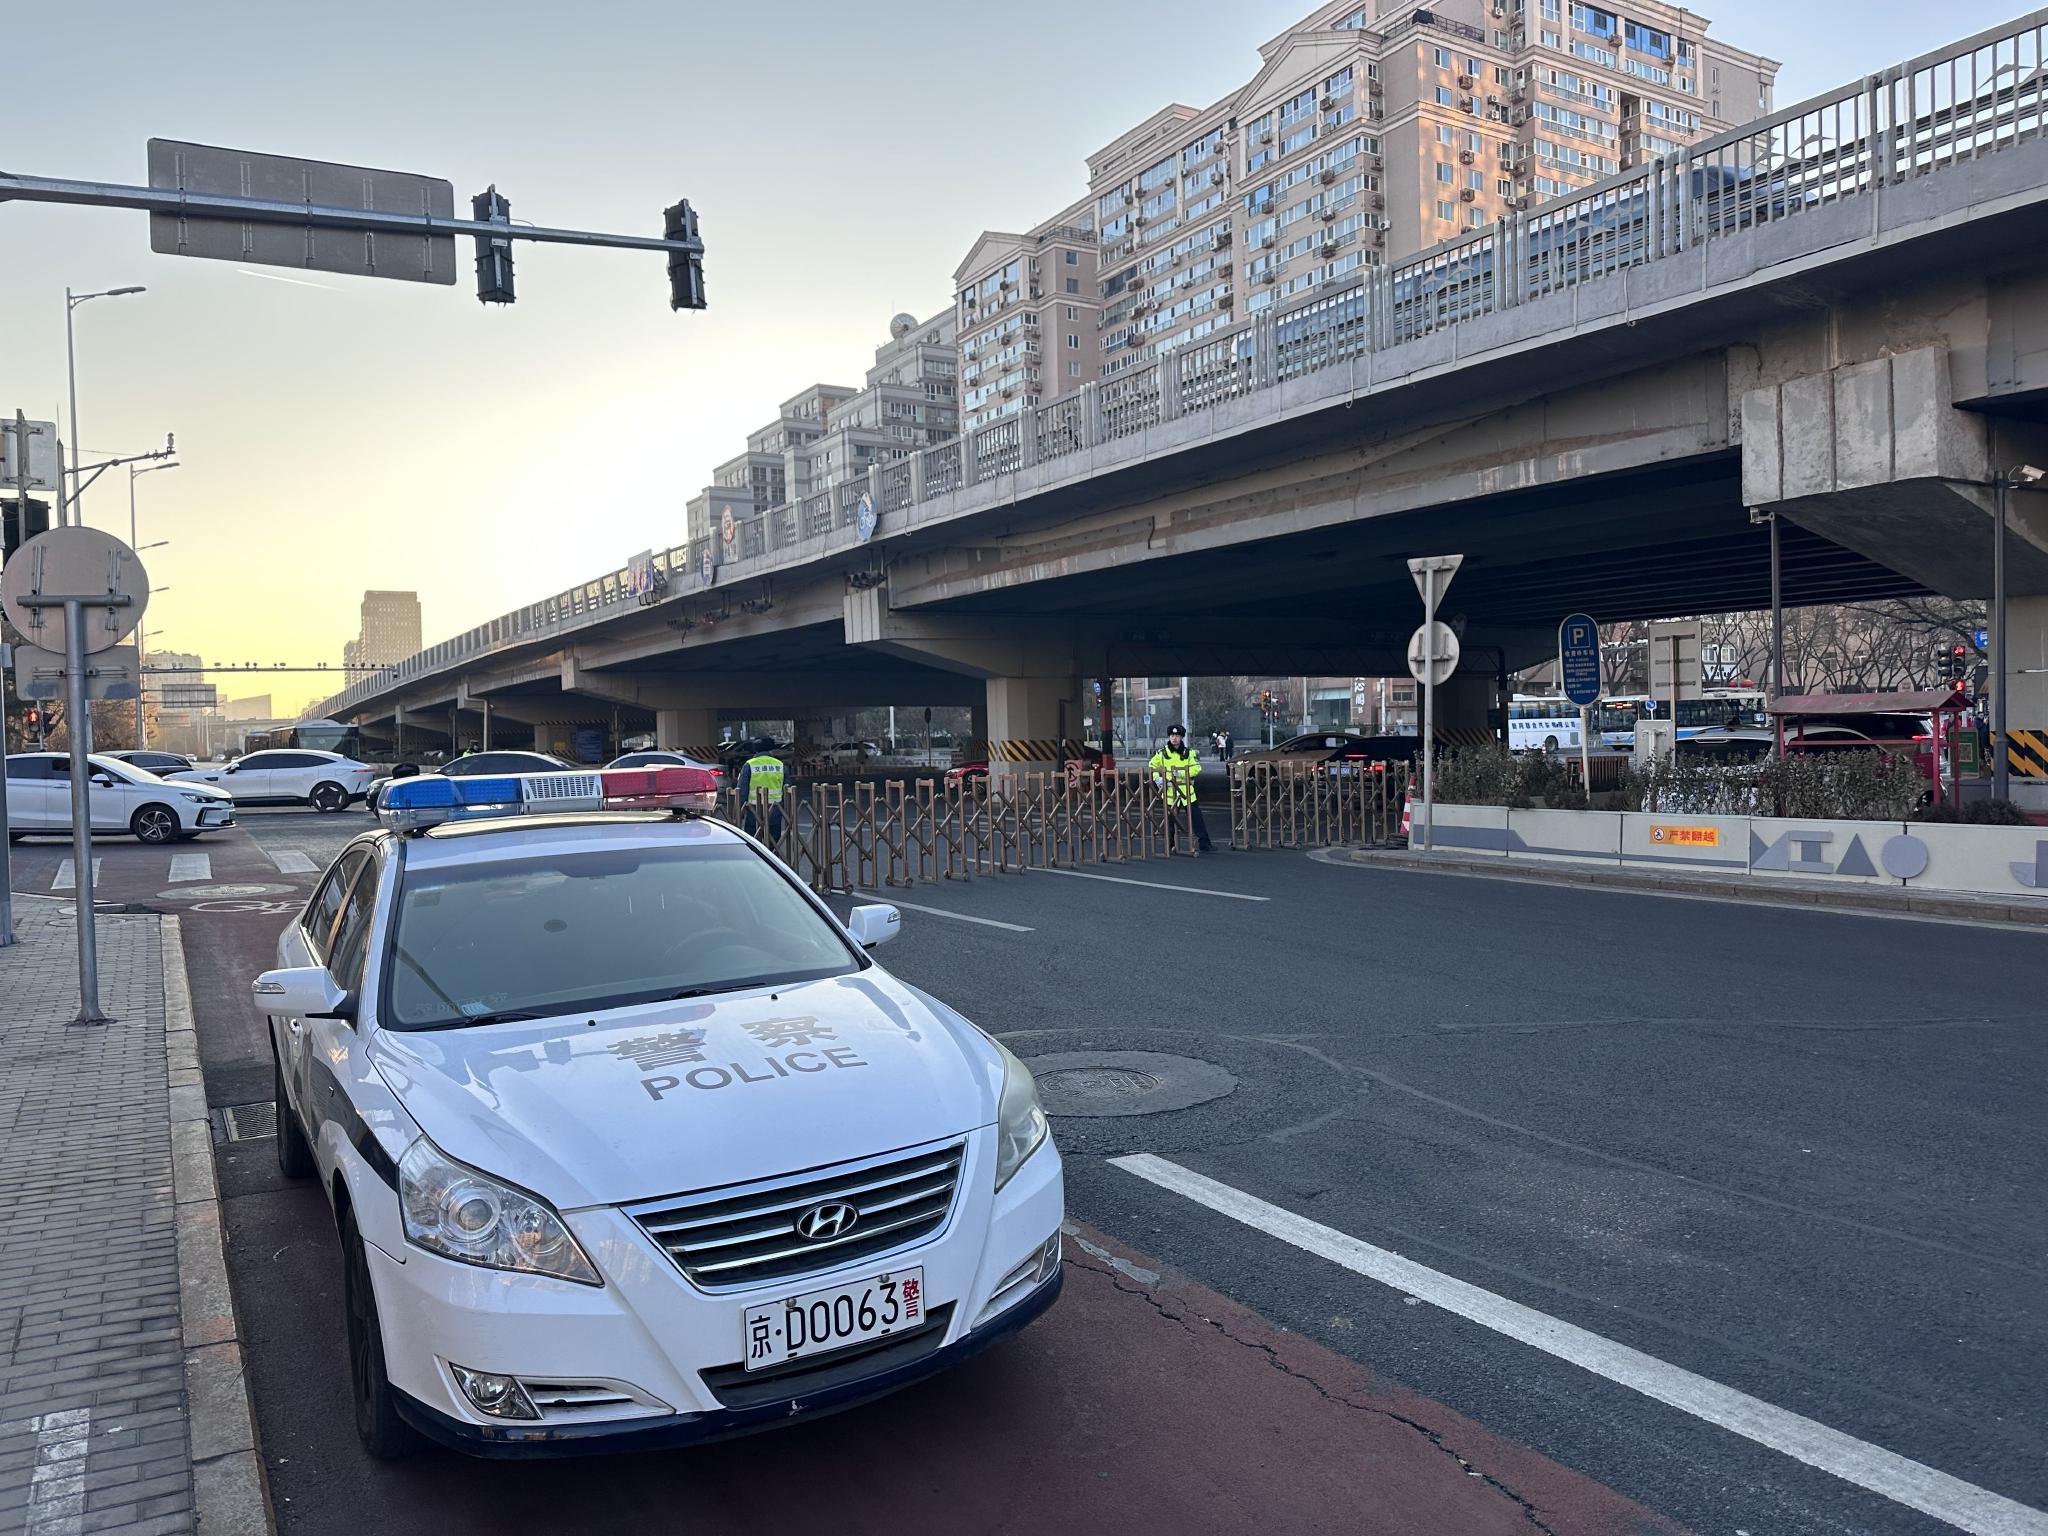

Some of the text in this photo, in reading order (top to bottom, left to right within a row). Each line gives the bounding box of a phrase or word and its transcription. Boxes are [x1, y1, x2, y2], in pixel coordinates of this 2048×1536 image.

[1572, 627, 1584, 645] P
[1668, 830, 1715, 842] 严禁翻越
[606, 1016, 838, 1071] 警察
[640, 1046, 868, 1101] POLICE
